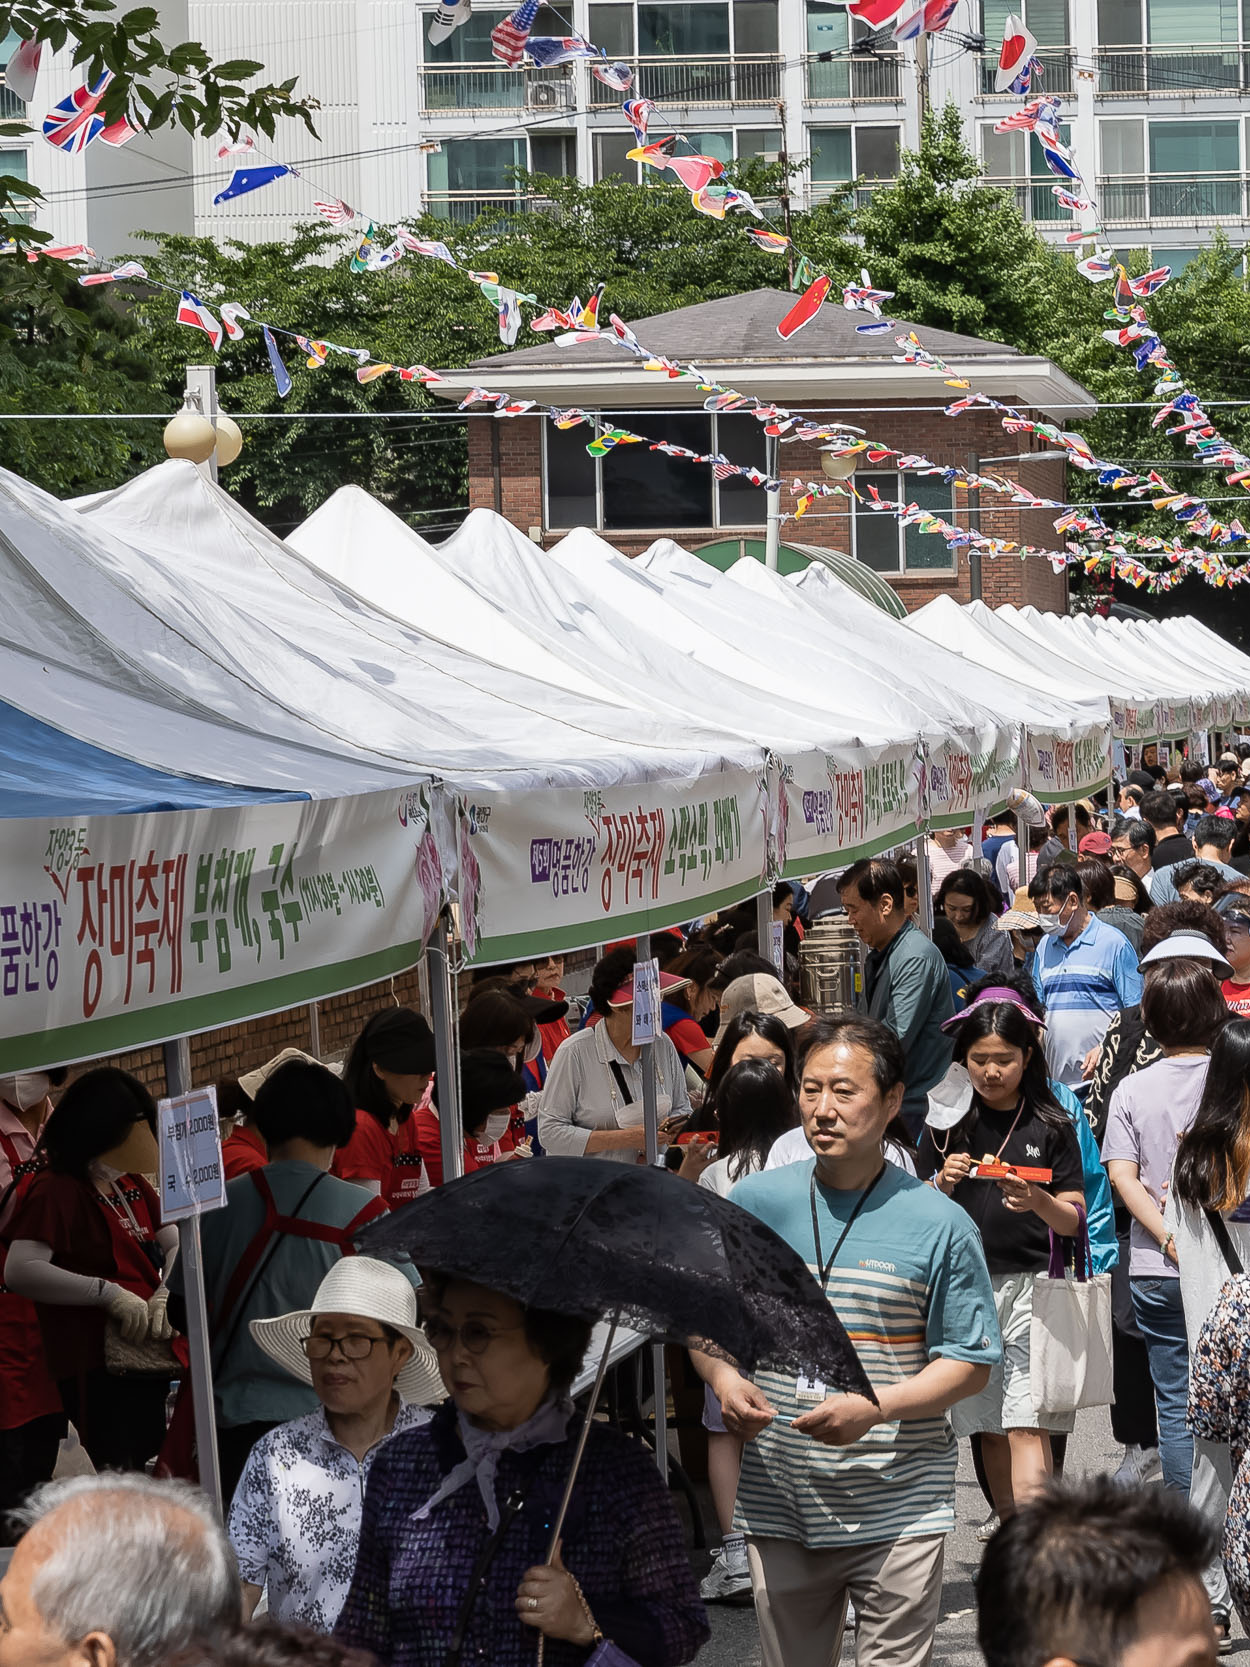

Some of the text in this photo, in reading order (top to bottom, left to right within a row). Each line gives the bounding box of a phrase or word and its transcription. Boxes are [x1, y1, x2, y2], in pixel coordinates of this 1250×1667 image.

[44, 827, 88, 873] 자양3동
[532, 839, 549, 876] 제5회
[551, 836, 596, 898] 명품한강
[601, 805, 665, 912] 장미축제
[76, 849, 189, 1018] 장미축제
[190, 847, 262, 974] 부침개,
[261, 843, 303, 961] 국수
[167, 1120, 187, 1142] 부침개
